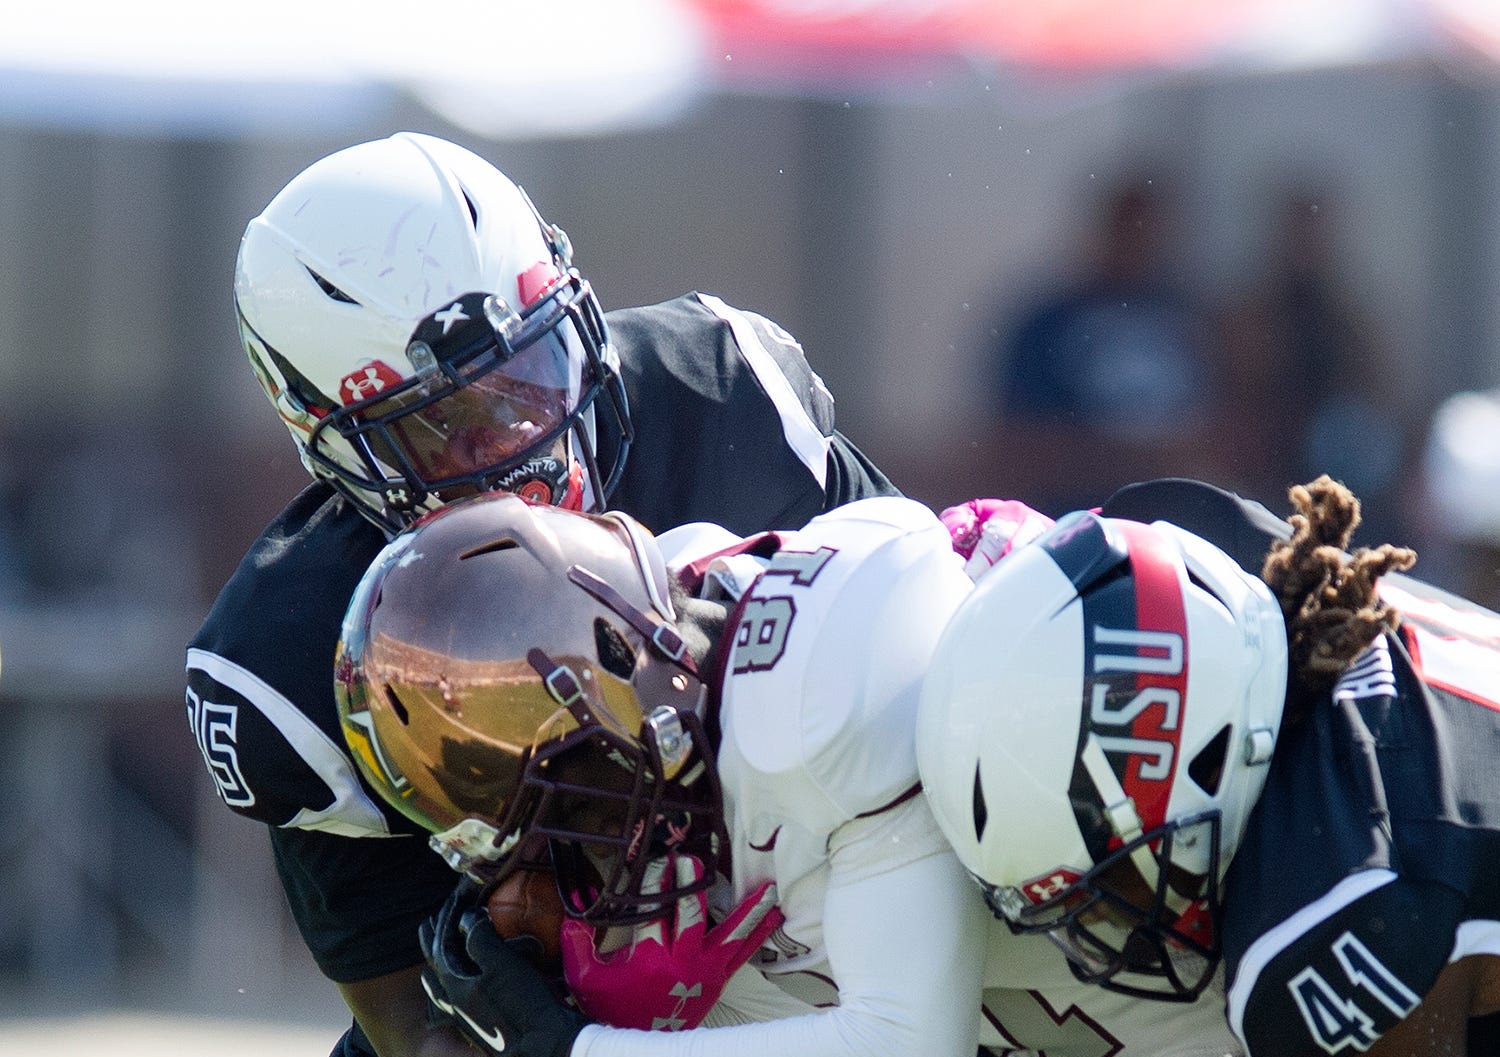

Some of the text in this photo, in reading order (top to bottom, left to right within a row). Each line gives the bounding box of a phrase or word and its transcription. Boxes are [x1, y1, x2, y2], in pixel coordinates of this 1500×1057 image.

[498, 460, 541, 487] WANT
[542, 459, 557, 472] TO
[1091, 624, 1184, 781] JSU
[1287, 930, 1423, 1056] 41
